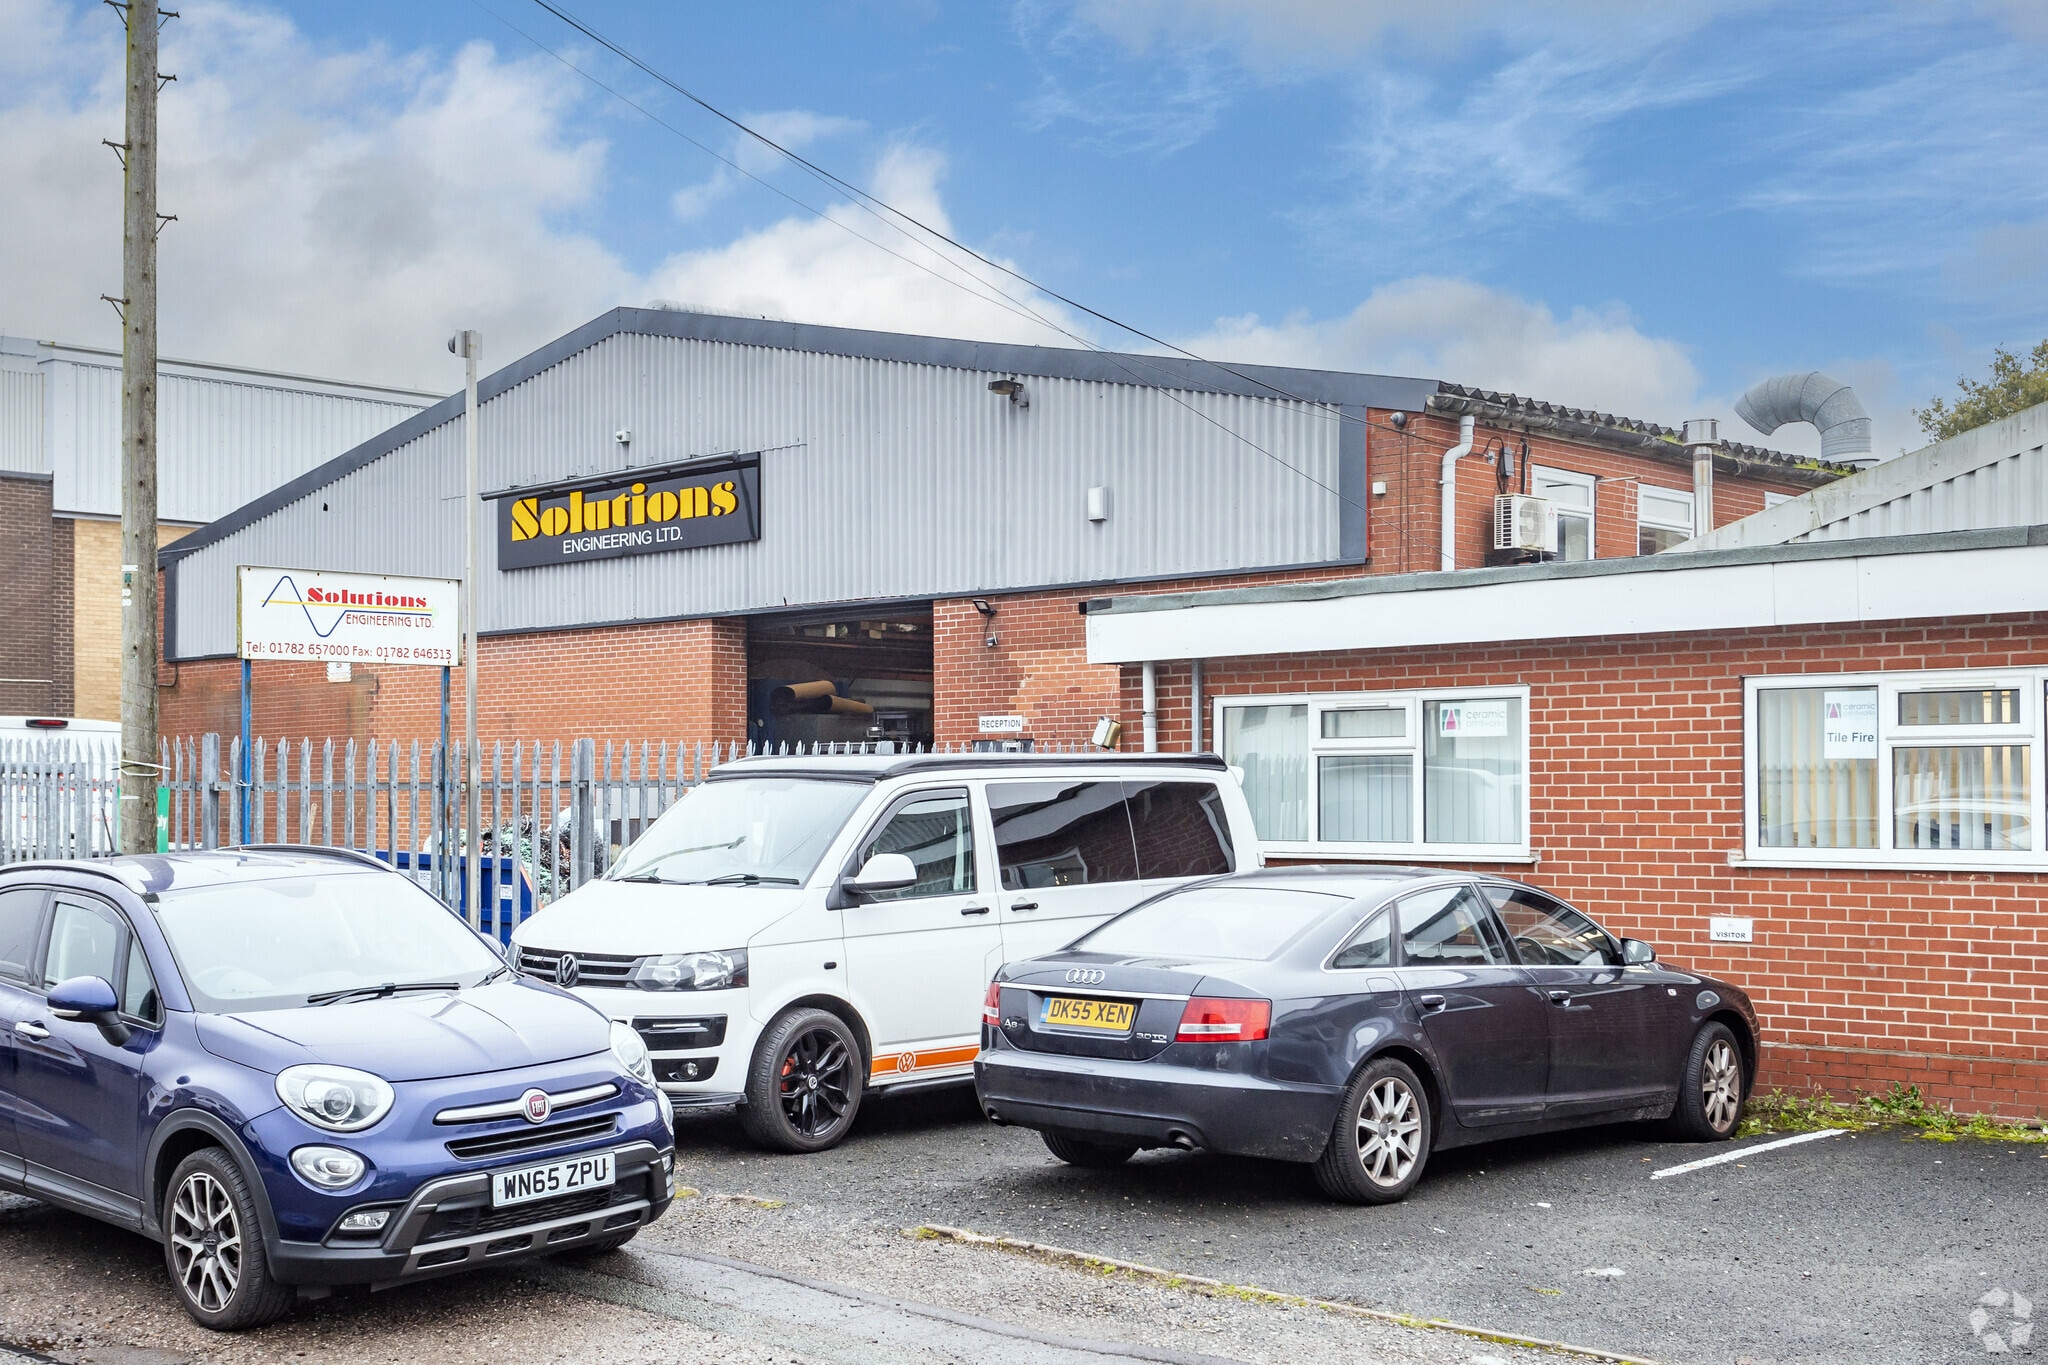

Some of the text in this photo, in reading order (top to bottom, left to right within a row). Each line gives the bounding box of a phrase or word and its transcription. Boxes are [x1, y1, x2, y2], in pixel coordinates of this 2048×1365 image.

[511, 481, 739, 542] Solutions
[563, 526, 683, 554] ENGINEERING LTD.
[307, 587, 427, 608] Solutions
[346, 614, 435, 628] ENGINEERING LTD.
[246, 641, 452, 660] Tel: 01782 657000 Fax: 01782 646313
[981, 719, 1021, 727] RECEPTION
[1466, 709, 1505, 719] ceramic
[1827, 732, 1875, 742] Tile Fire
[1050, 1000, 1129, 1024] DK55 XEN
[531, 1099, 545, 1114] FIAT
[504, 1158, 607, 1200] WN65 ZPU
